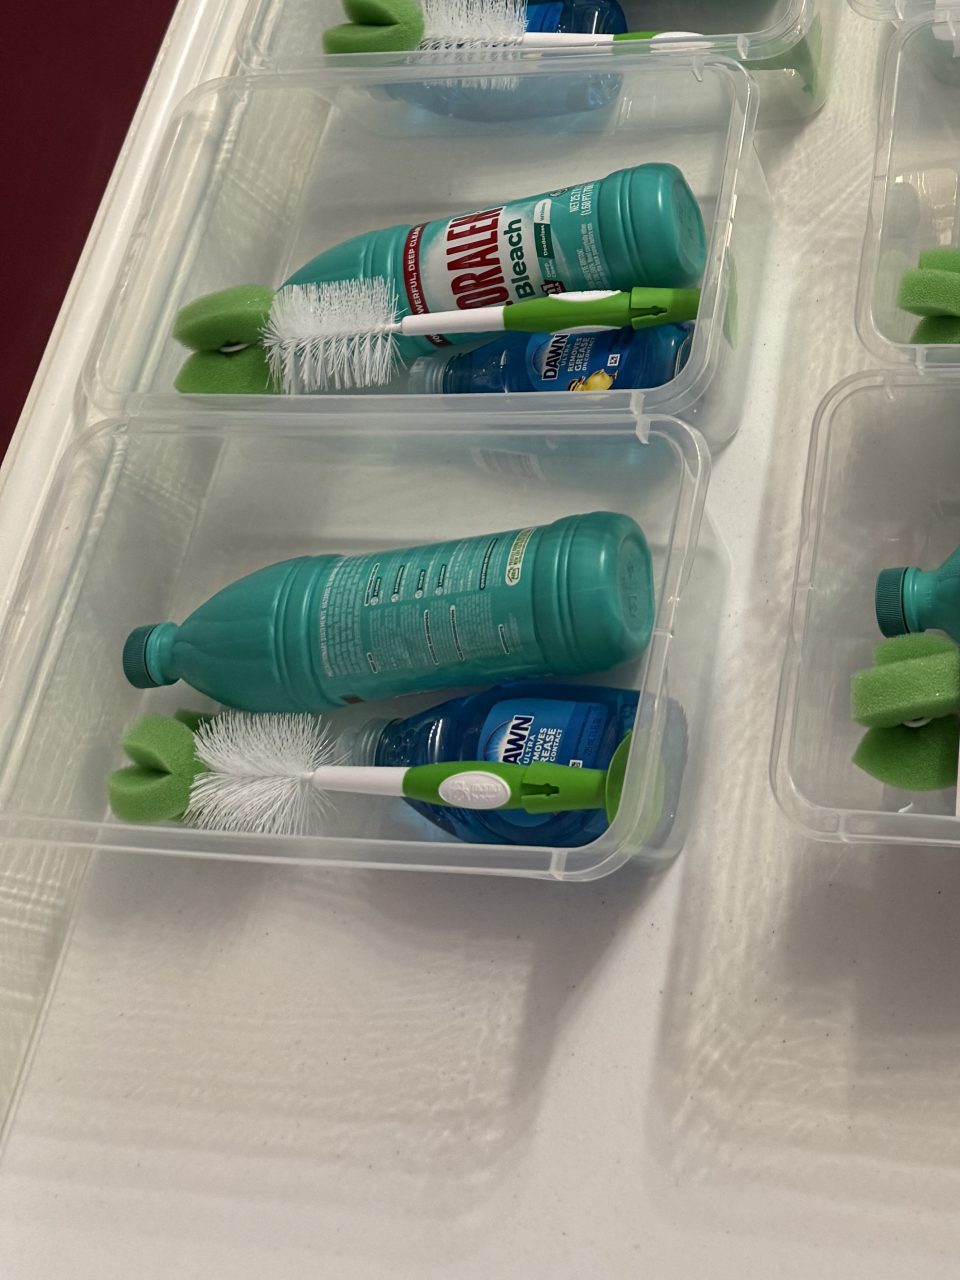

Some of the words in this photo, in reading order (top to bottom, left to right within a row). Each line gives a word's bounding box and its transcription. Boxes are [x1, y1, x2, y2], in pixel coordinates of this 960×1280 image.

[408, 248, 416, 271] DEEP
[504, 218, 535, 299] Bleach
[542, 334, 569, 379] DAWN
[568, 338, 581, 372] REMOVES
[575, 338, 590, 371] GREASE
[502, 716, 533, 764] AWN
[523, 735, 535, 764] ULTRA
[542, 728, 557, 762] REASE
[550, 729, 562, 762] CONTACT
